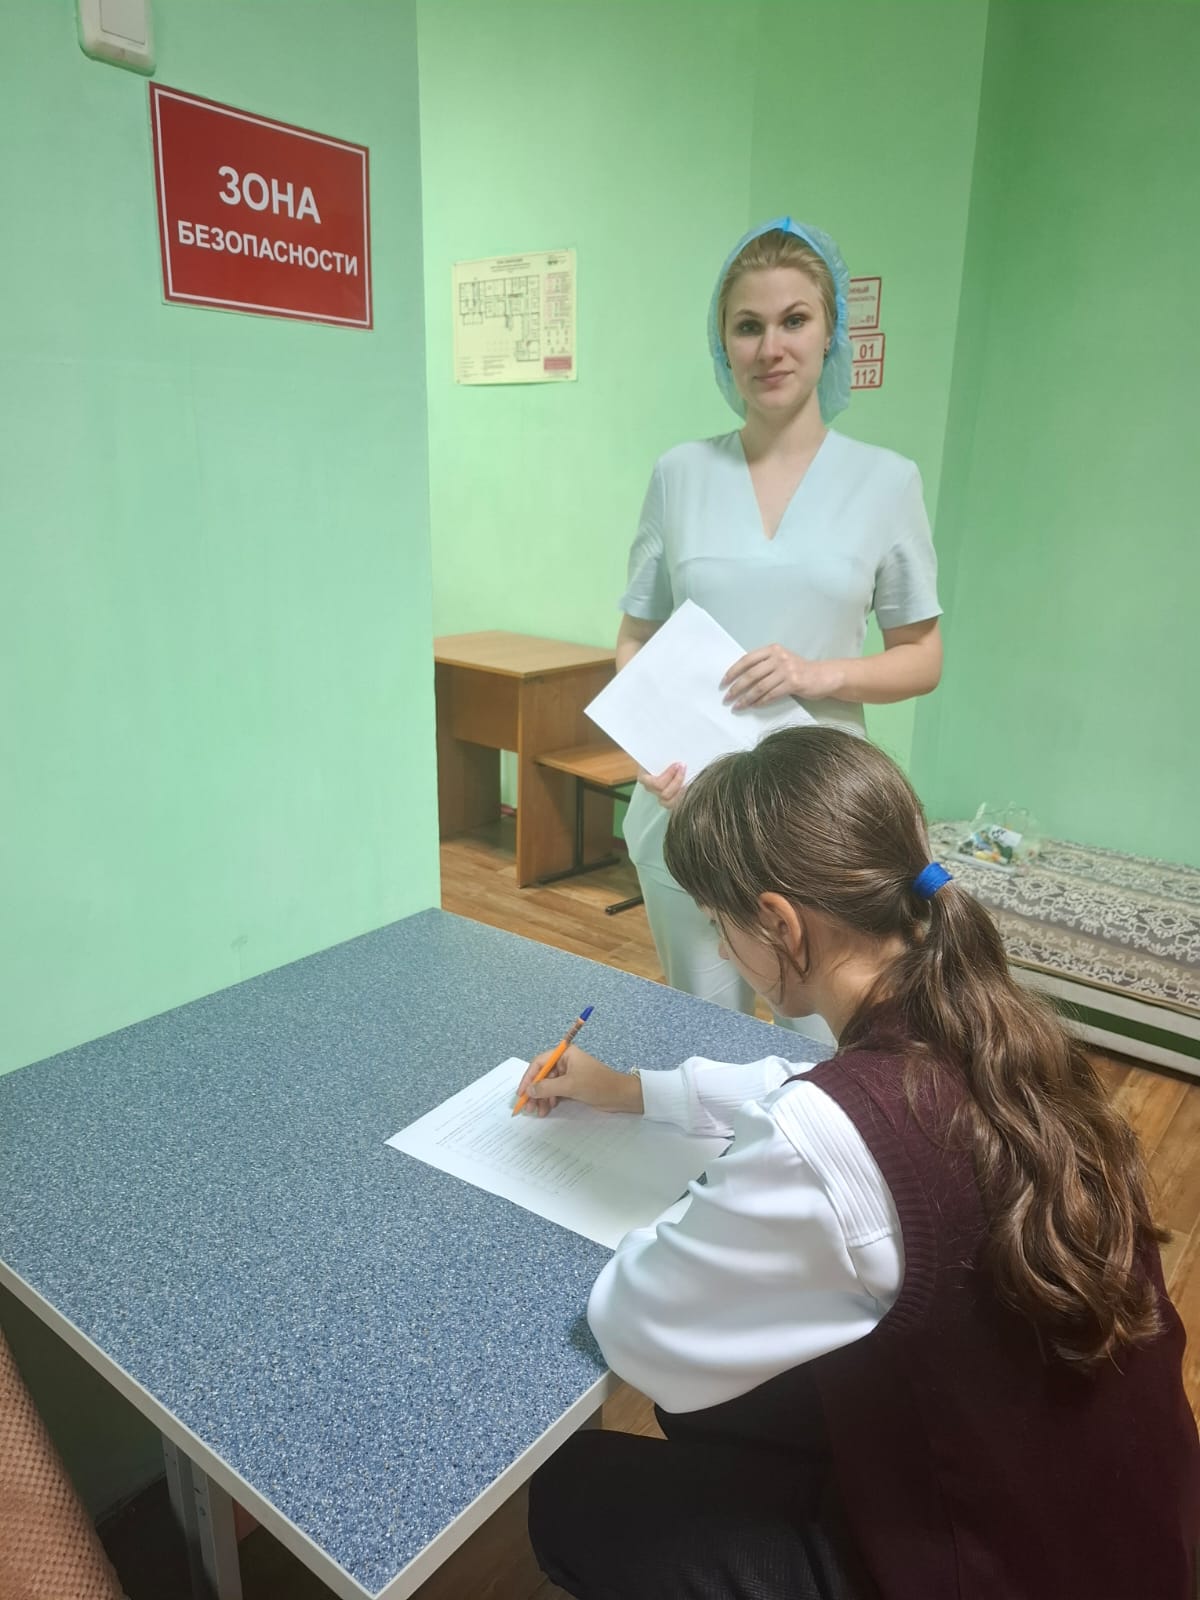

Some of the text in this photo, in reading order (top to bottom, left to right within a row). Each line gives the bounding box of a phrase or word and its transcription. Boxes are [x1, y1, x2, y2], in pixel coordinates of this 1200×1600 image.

[218, 166, 321, 225] ЗОНА
[178, 220, 358, 277] БЕЗОПАСНОСТИ
[860, 343, 875, 359] 01
[854, 368, 877, 385] 112
